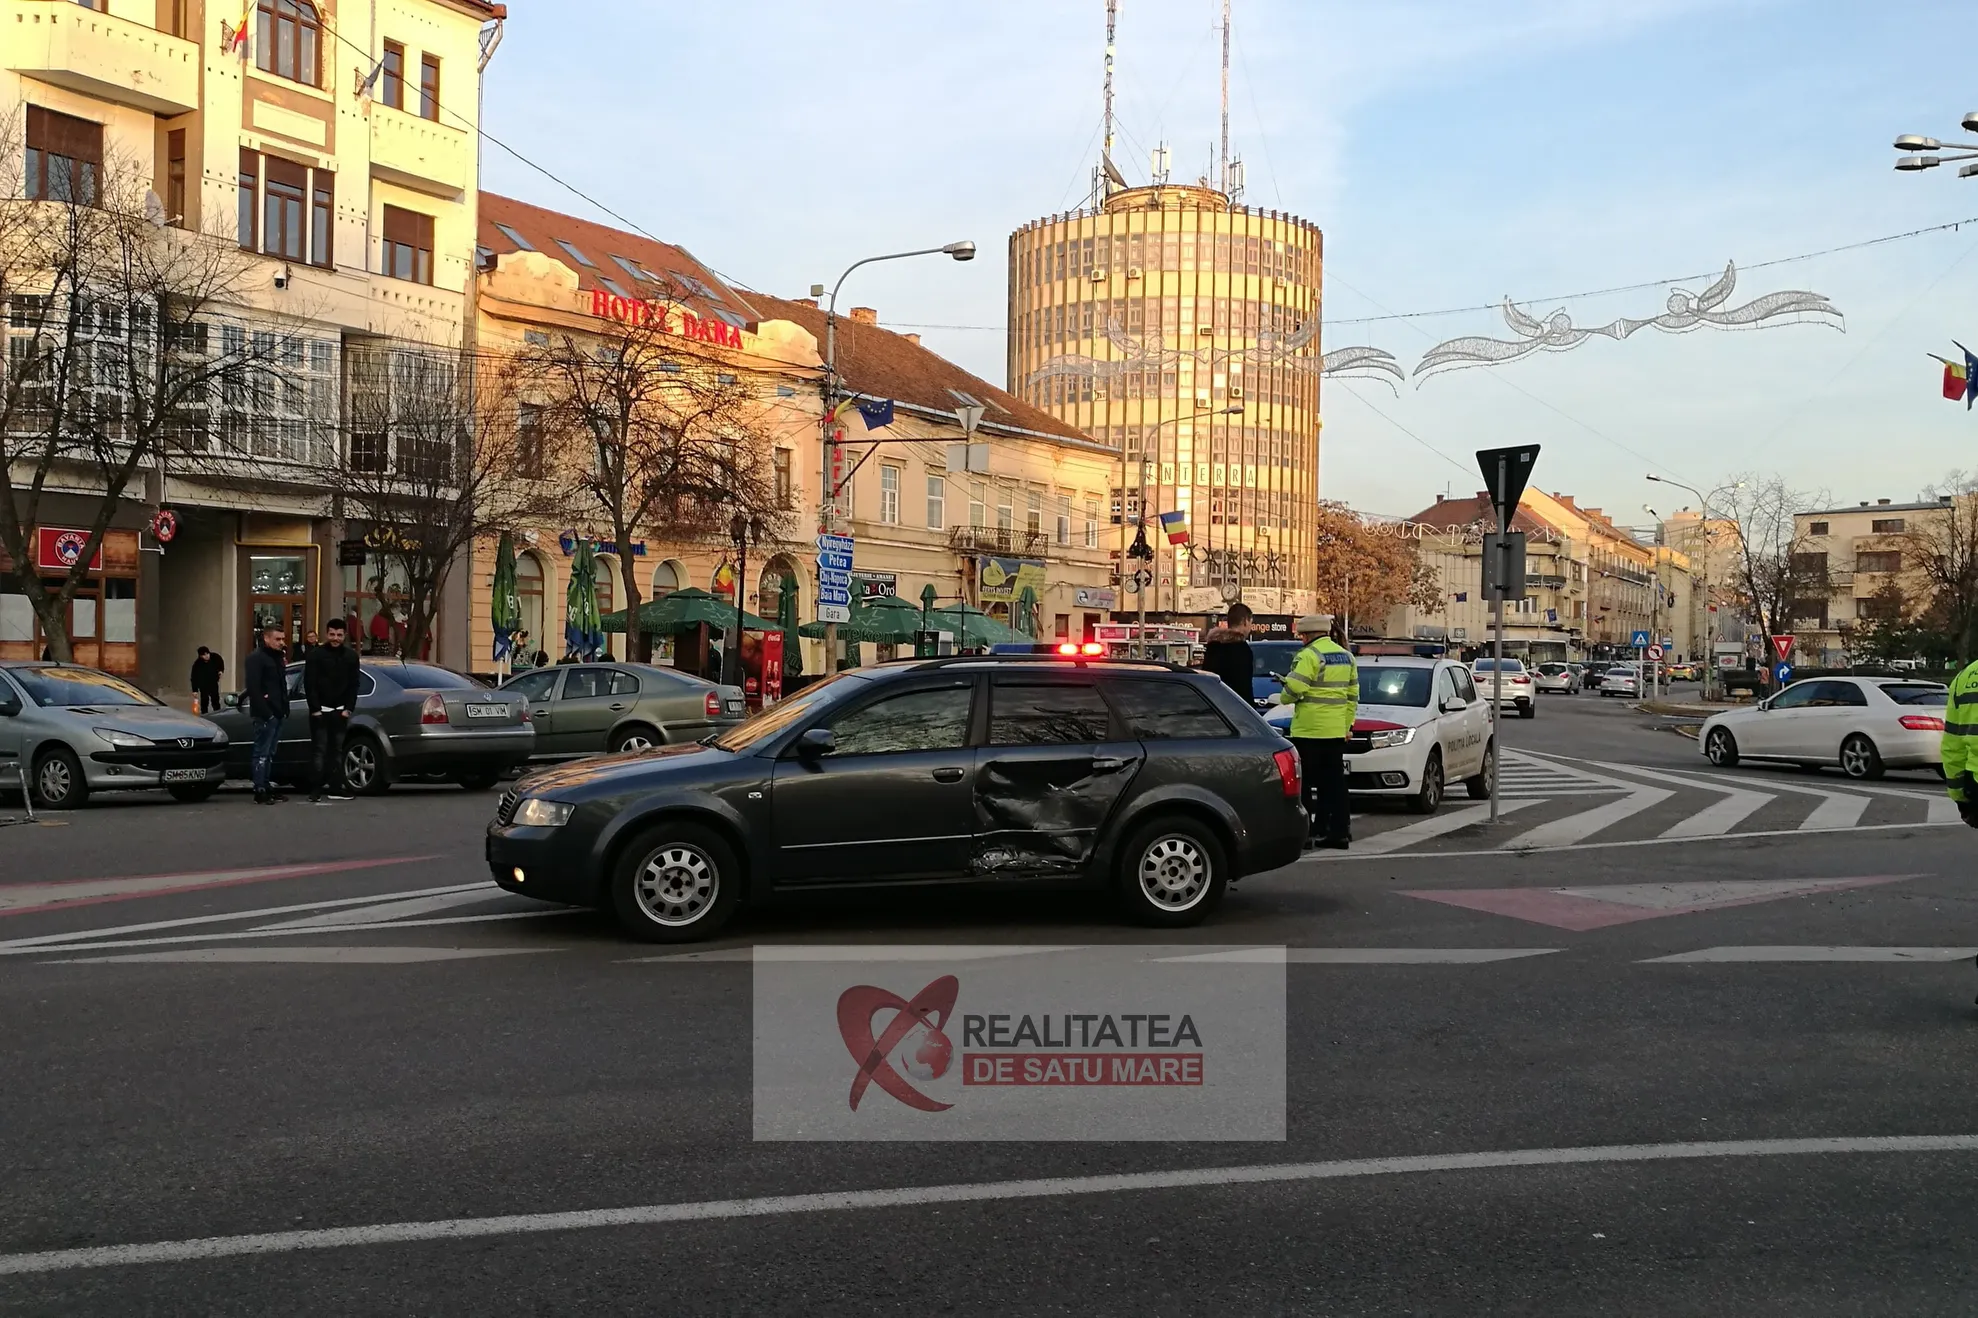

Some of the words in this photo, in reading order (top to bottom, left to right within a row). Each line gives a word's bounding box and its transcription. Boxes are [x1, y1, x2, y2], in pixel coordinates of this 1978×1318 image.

[592, 289, 674, 333] HOTEL
[56, 534, 85, 549] BAVARIA
[829, 553, 847, 568] Petea
[821, 588, 832, 600] Baia
[833, 590, 846, 602] Mare
[826, 607, 840, 619] Gara
[1271, 623, 1287, 632] store
